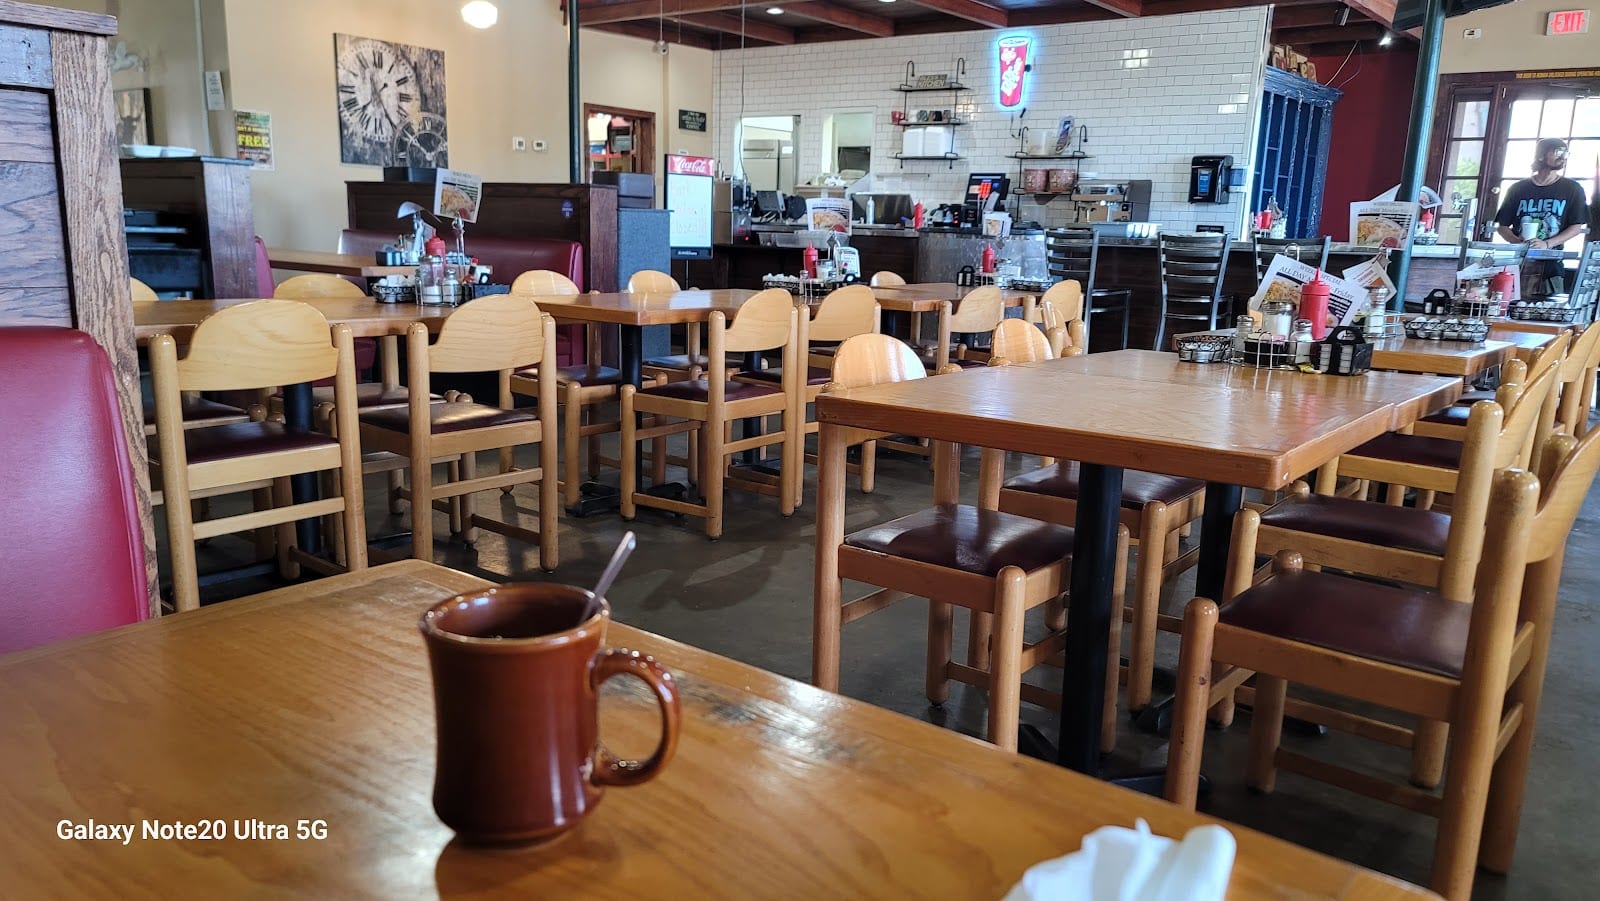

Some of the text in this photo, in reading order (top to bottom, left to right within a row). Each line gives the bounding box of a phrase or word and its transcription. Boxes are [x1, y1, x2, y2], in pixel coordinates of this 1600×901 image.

[1553, 12, 1584, 33] EXIT
[238, 134, 270, 148] FREE
[1516, 199, 1567, 216] ALIEN
[1280, 266, 1292, 275] ALL
[1292, 270, 1305, 280] DAY
